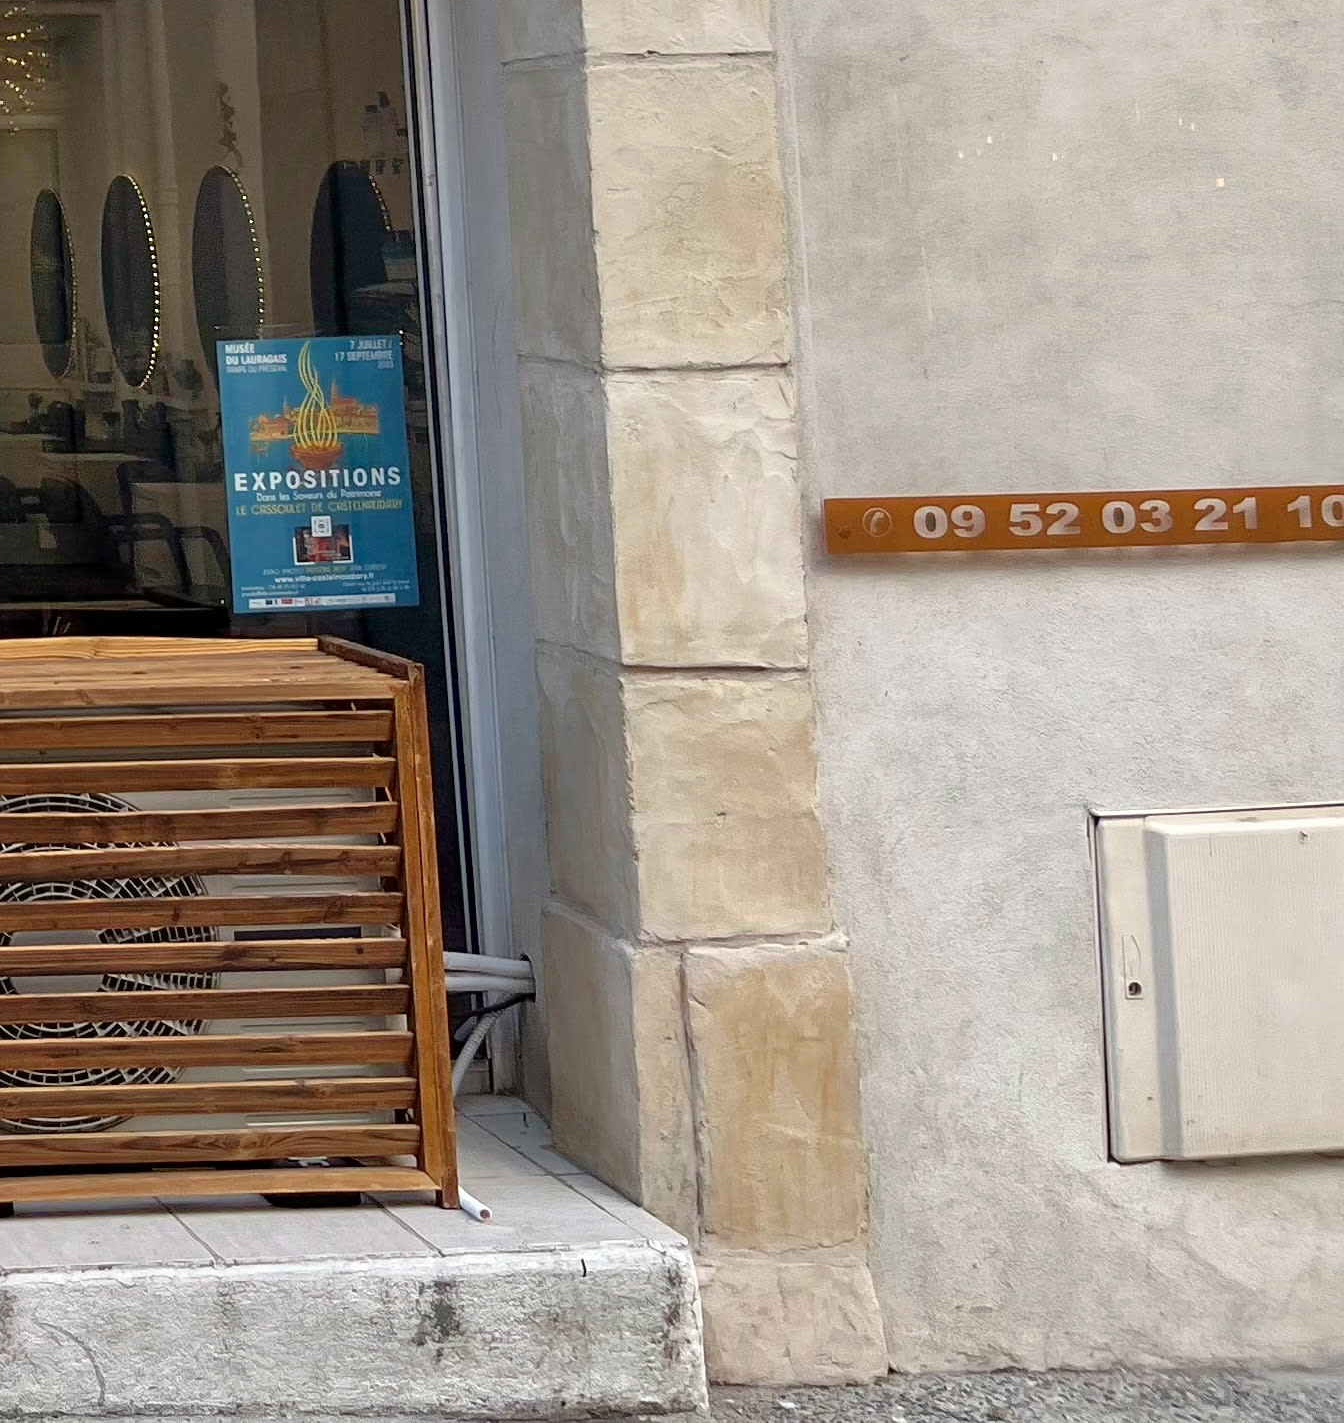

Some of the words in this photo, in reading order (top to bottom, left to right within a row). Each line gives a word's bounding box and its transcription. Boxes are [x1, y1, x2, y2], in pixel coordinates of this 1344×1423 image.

[224, 342, 255, 354] MUSÉE
[225, 355, 239, 365] DU
[334, 351, 345, 362] 17
[347, 350, 393, 362] SEPTEMBRE
[234, 466, 401, 492] EXPOSITIONS
[913, 504, 987, 539] 09
[1008, 502, 1082, 537] 52
[1101, 499, 1174, 535] 03
[1194, 496, 1258, 532] 21
[1287, 494, 1344, 529] 10
